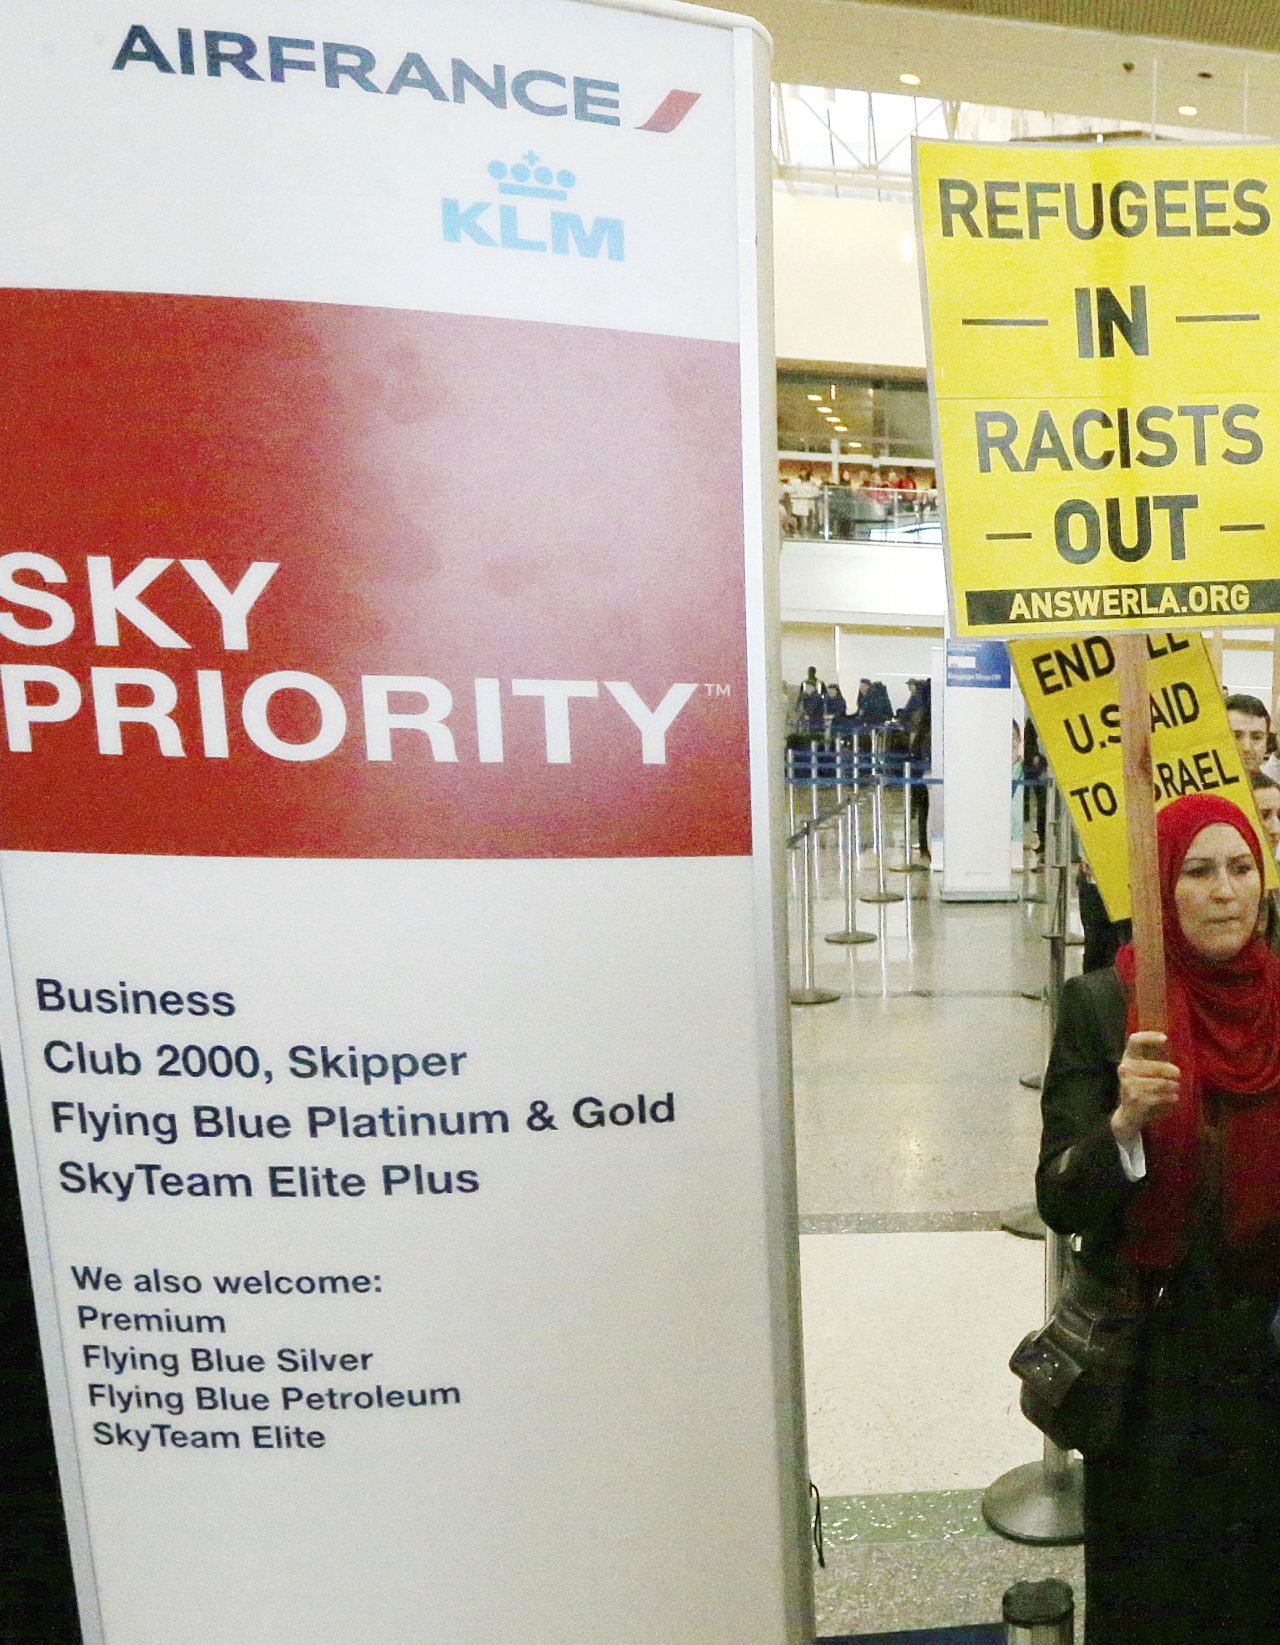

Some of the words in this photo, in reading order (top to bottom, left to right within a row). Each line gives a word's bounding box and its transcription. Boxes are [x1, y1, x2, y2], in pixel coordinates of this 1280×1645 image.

[111, 25, 621, 127] AIRFRANCE
[441, 197, 626, 262] KLM
[938, 178, 1272, 240] REFUGEES
[1074, 285, 1150, 359] IN
[974, 403, 1264, 474] RACISTS
[1053, 494, 1199, 565] OUT
[0, 552, 280, 651] SKY
[1008, 584, 1250, 620] ANSWERLA.ORG
[1031, 635, 1116, 696] END
[1146, 633, 1190, 659] LL
[1150, 681, 1200, 733] AID
[1069, 782, 1119, 822] TO
[1153, 749, 1240, 801] RAEL
[36, 979, 236, 1017] Business
[43, 1041, 141, 1077] Club
[155, 1045, 275, 1084] 2000,
[288, 1046, 468, 1085] Skipper
[52, 1101, 179, 1144] Flying
[193, 1105, 292, 1139] Blue
[308, 1102, 509, 1139] Platinum
[526, 1101, 559, 1132] &
[572, 1092, 676, 1129] Gold
[58, 1162, 253, 1201] SkyTeam
[269, 1164, 366, 1197] Elite
[383, 1163, 481, 1195] Plus
[72, 1265, 122, 1293] We
[134, 1267, 203, 1293] also
[214, 1269, 383, 1294] welcome:
[77, 1305, 226, 1334] Premium
[83, 1344, 180, 1377] Flying
[191, 1346, 266, 1373] Blue
[277, 1346, 374, 1374] Silver
[88, 1384, 184, 1416] Flying
[196, 1386, 270, 1412] Blue
[281, 1382, 461, 1411] Petroleum
[93, 1422, 241, 1454] SkyTeam
[253, 1424, 327, 1449] Elite
